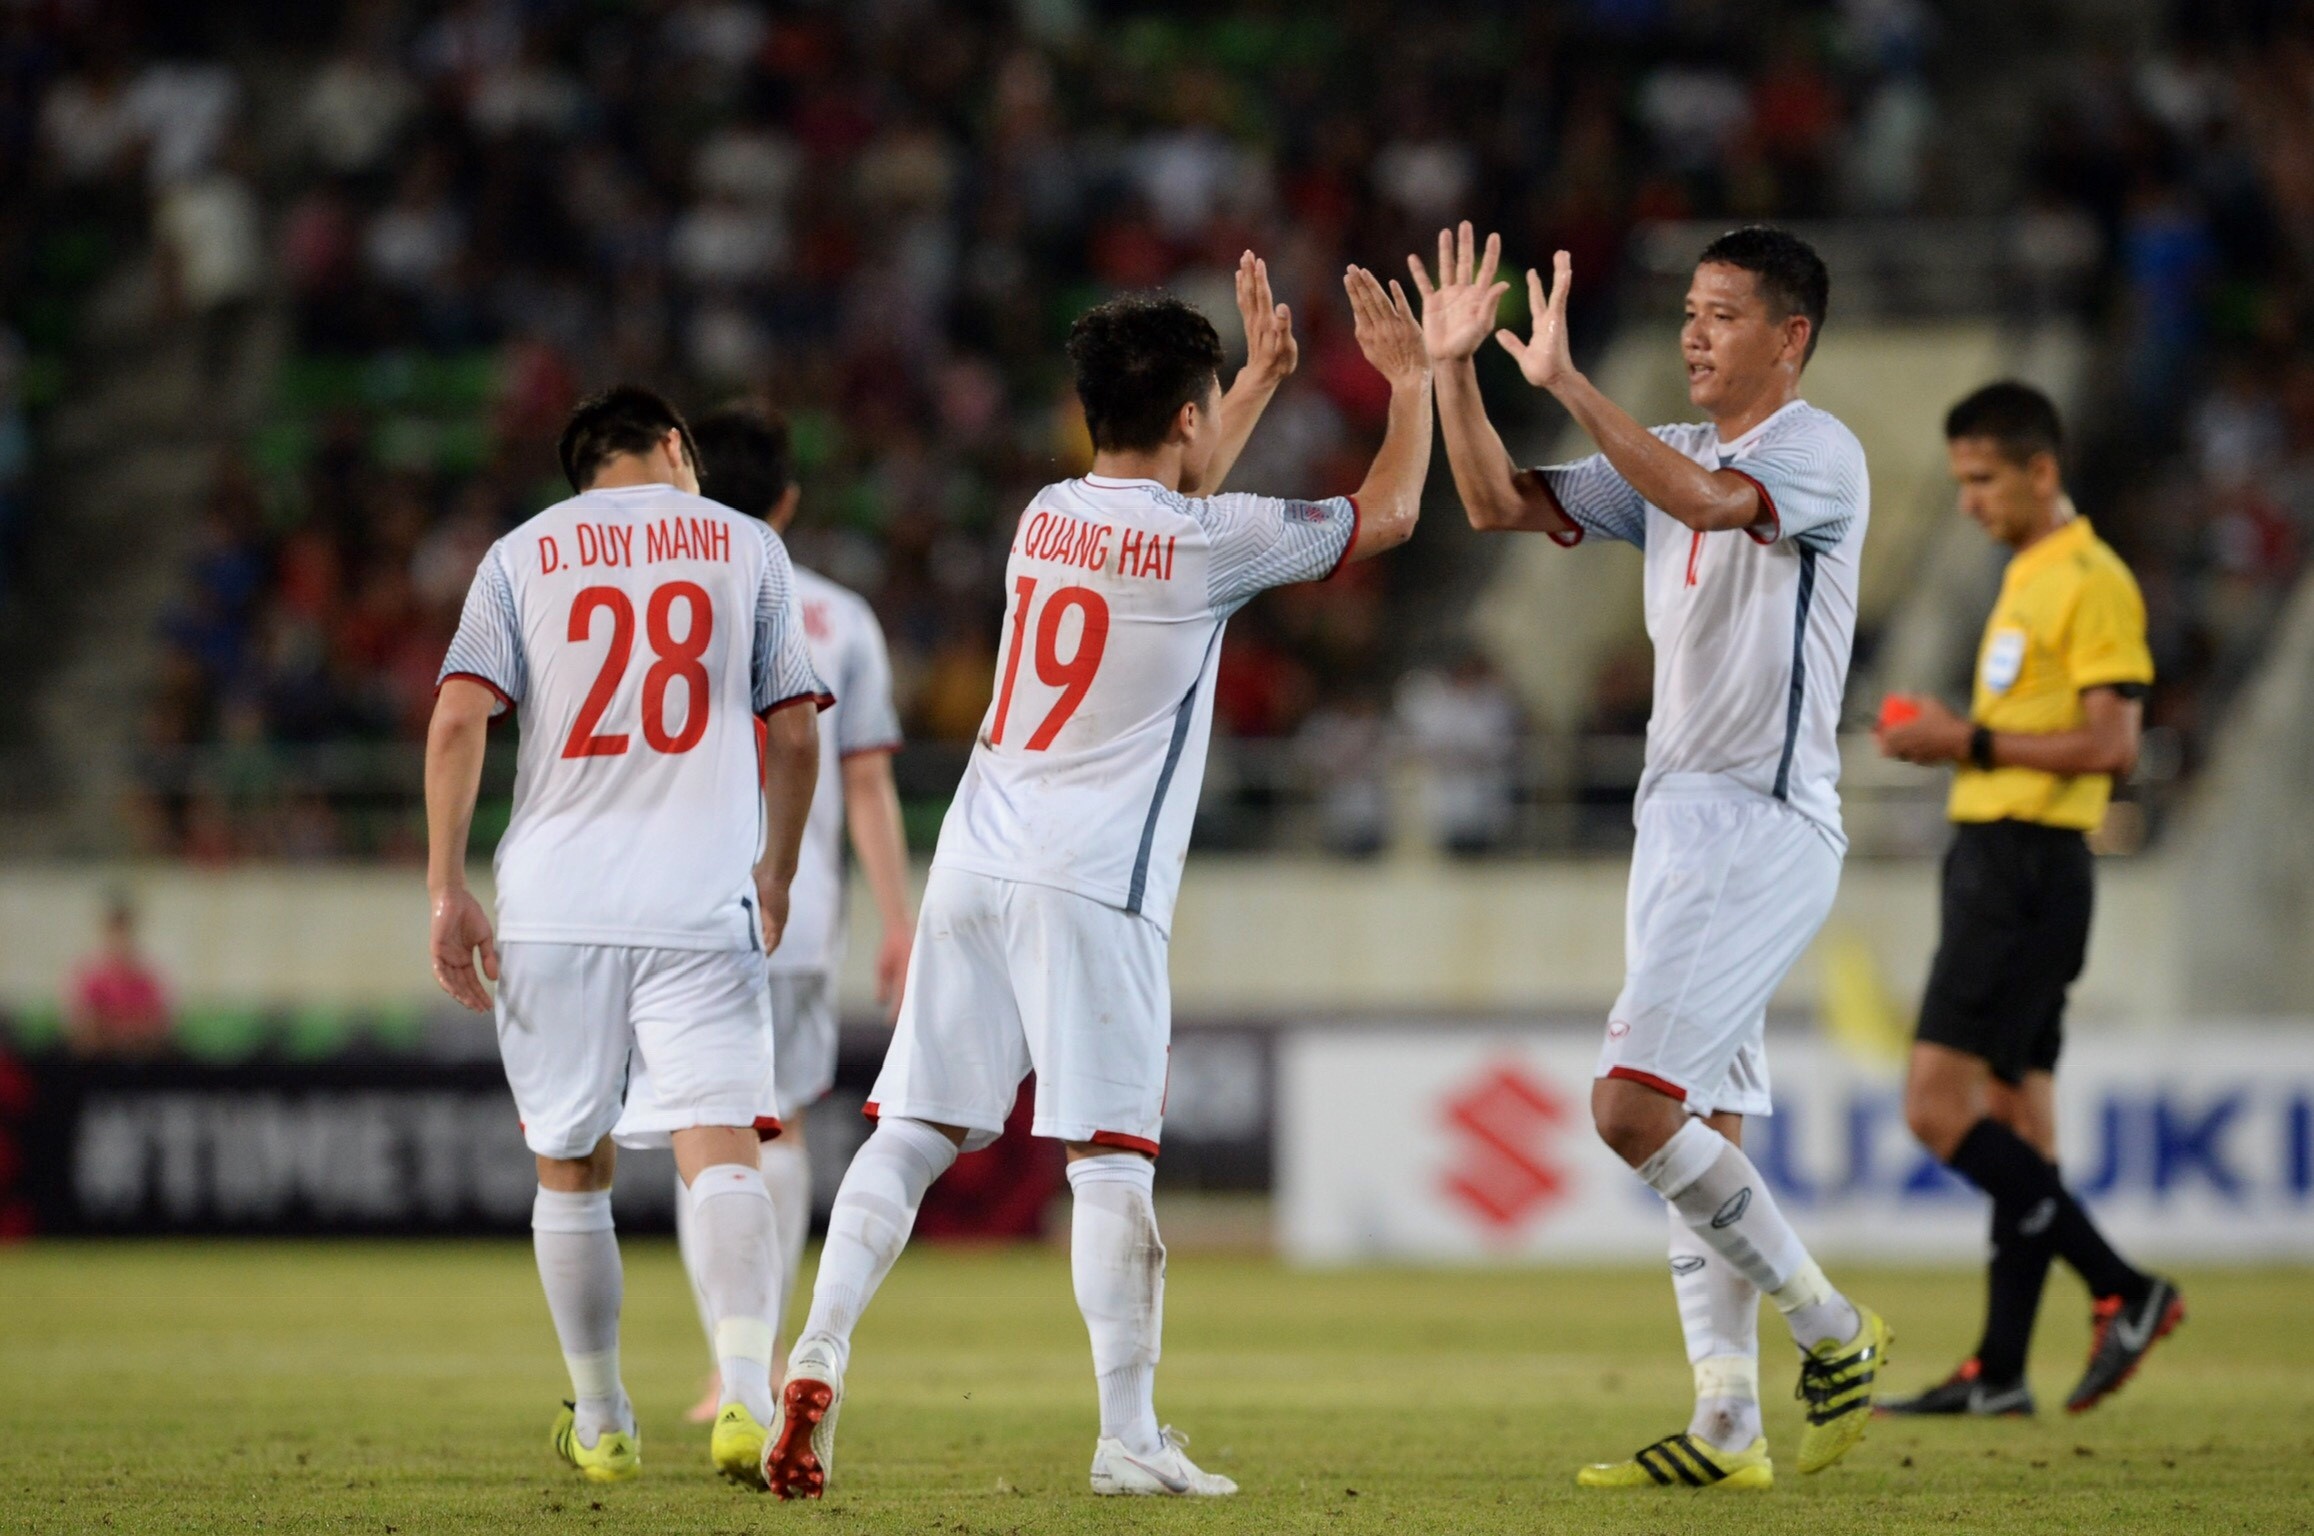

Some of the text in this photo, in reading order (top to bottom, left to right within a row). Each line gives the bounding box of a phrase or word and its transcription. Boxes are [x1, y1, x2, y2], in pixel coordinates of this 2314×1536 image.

[538, 516, 730, 576] D. DUY MANH
[1025, 511, 1112, 571] QUANG
[1117, 527, 1176, 581] HAI
[561, 580, 713, 760] 28
[990, 575, 1110, 752] 19
